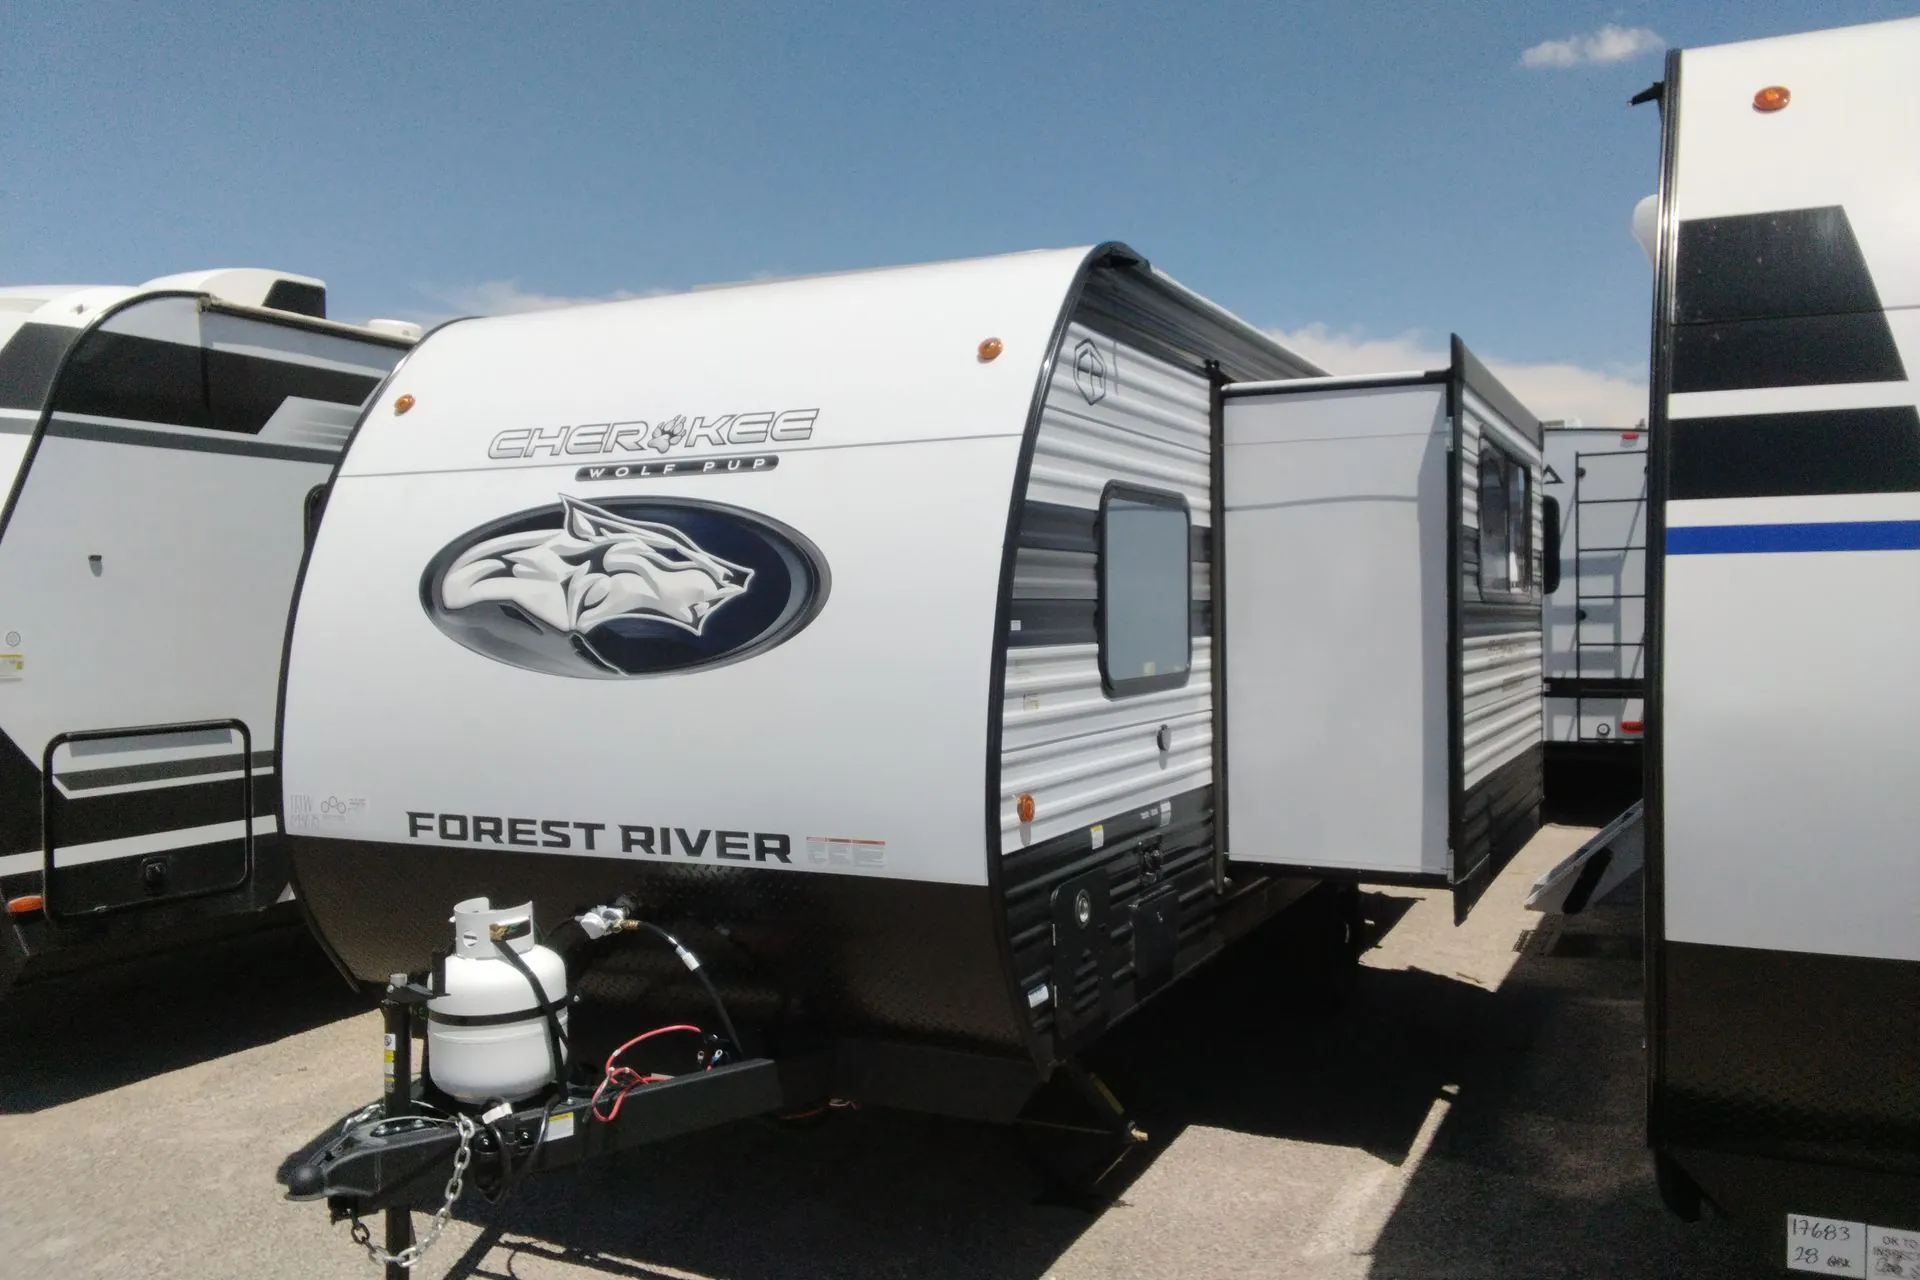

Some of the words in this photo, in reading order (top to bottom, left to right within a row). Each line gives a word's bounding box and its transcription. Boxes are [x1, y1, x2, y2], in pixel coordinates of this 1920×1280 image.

[589, 463, 675, 479] WOLF
[703, 458, 766, 473] PUP
[406, 811, 605, 850] FOREST
[617, 824, 793, 865] RIVER
[1793, 1219, 1850, 1240] 17683
[1795, 1246, 1819, 1264] 28
